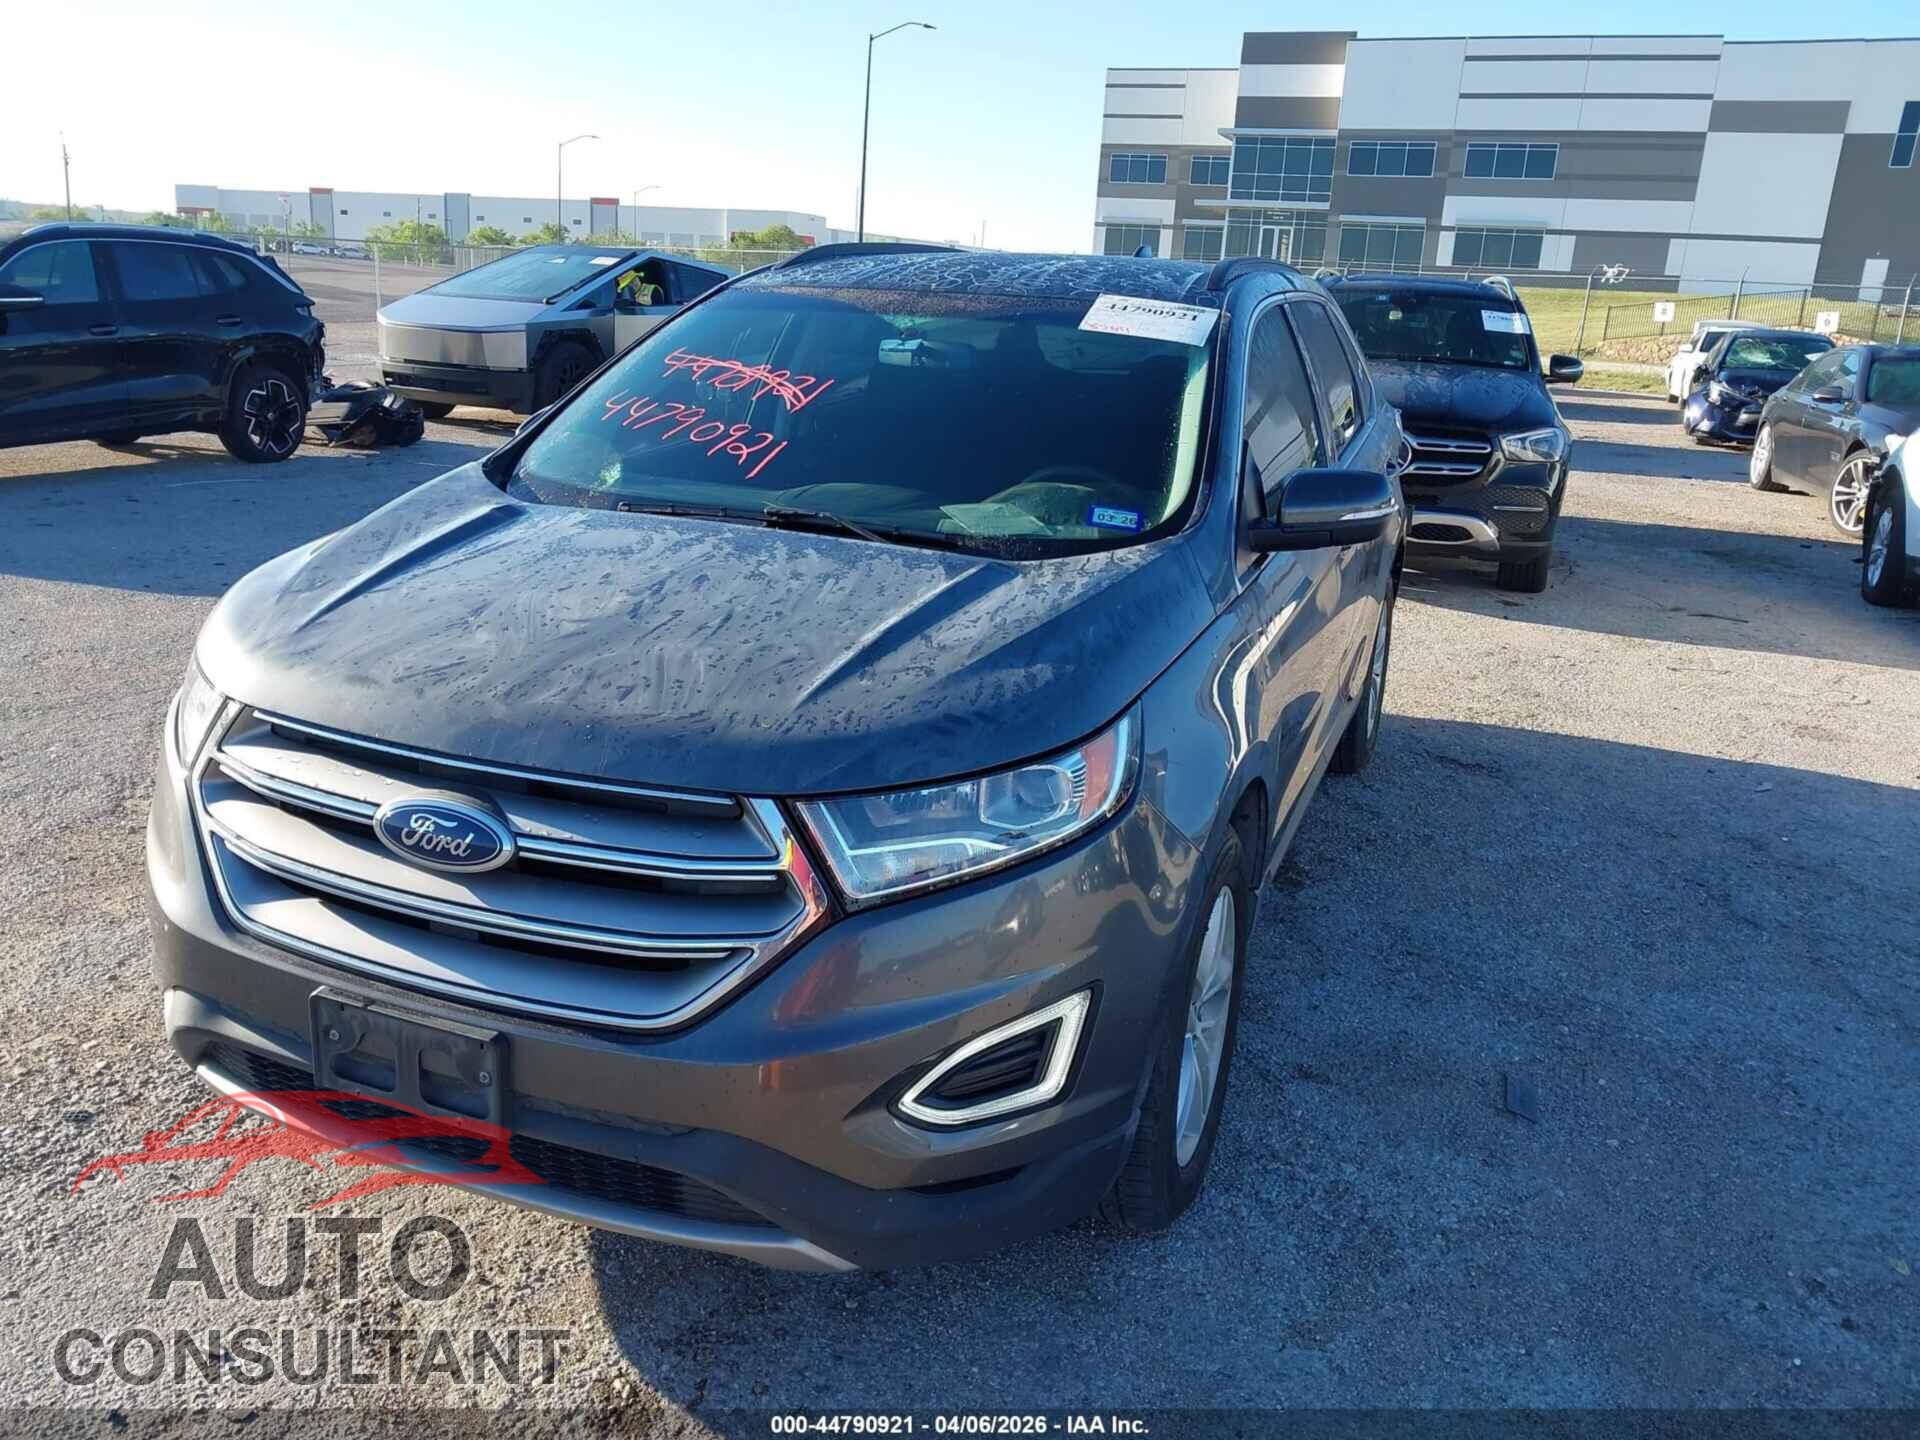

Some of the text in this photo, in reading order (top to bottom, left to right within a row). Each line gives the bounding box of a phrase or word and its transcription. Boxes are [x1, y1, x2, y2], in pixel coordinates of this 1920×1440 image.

[1105, 303, 1198, 321] 44790921
[602, 390, 788, 479] 44790921
[401, 813, 474, 857] Ford
